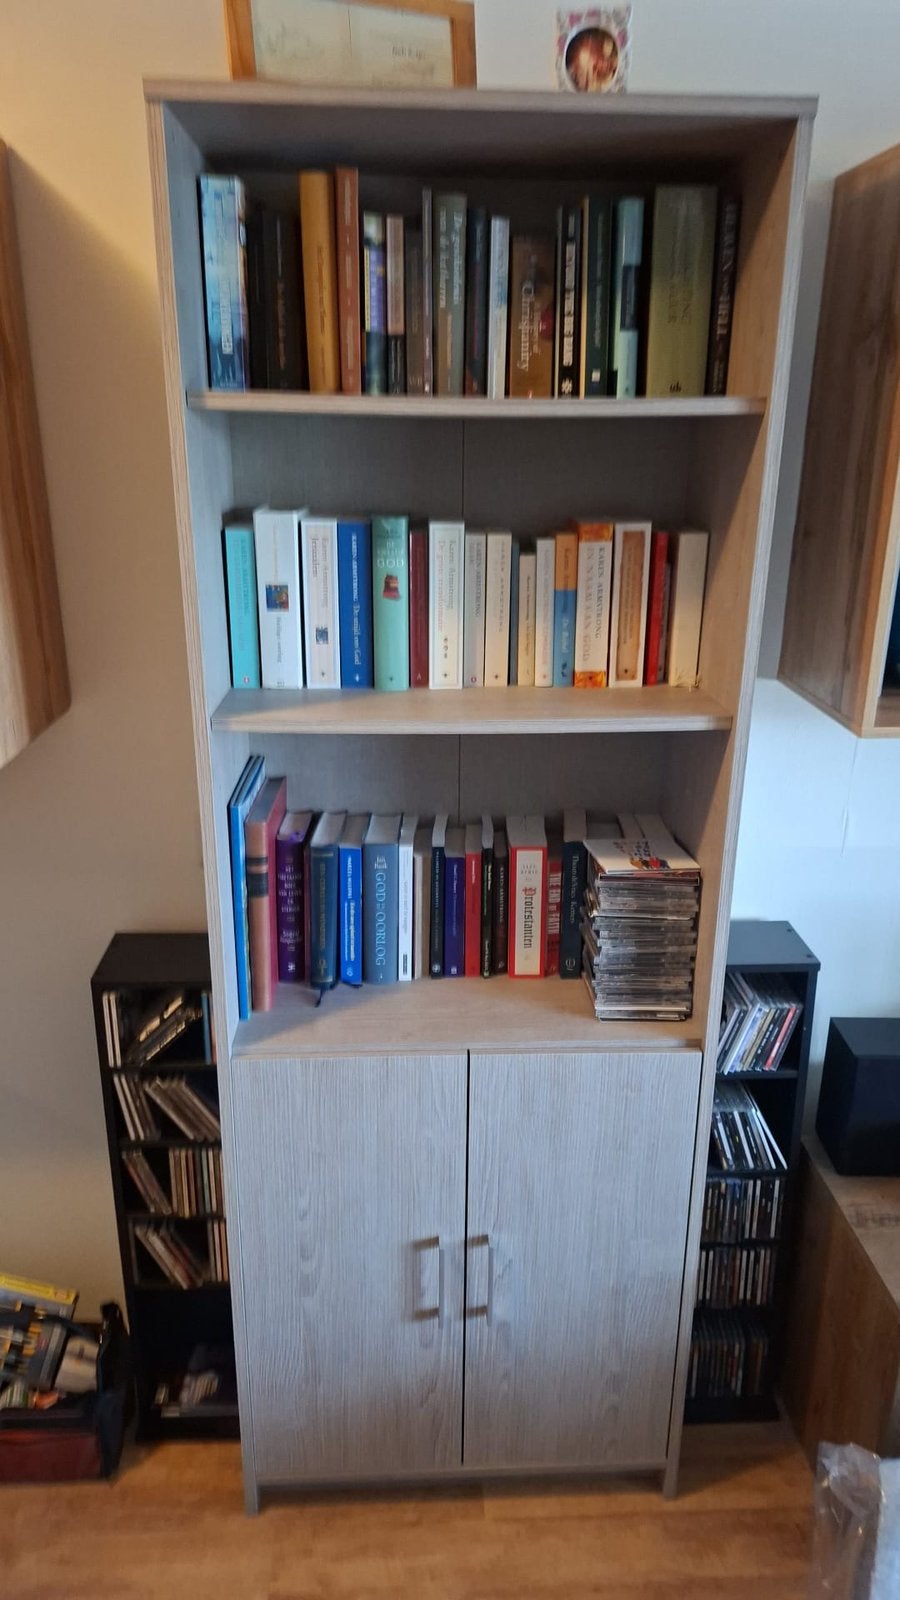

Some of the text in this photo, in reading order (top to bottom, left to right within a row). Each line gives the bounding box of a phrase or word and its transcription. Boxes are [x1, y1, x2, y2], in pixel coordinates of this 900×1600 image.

[517, 280, 535, 371] Christianity
[582, 548, 594, 663] IN NAAM VAN GOD
[594, 547, 606, 639] KAREN ARMSTRONG
[354, 649, 362, 665] God
[375, 872, 386, 902] GOD
[548, 888, 561, 903] END
[549, 872, 562, 886] THE
[375, 911, 386, 966] OORLOG
[521, 887, 537, 949] Protestanten
[548, 912, 560, 935] FAITH
